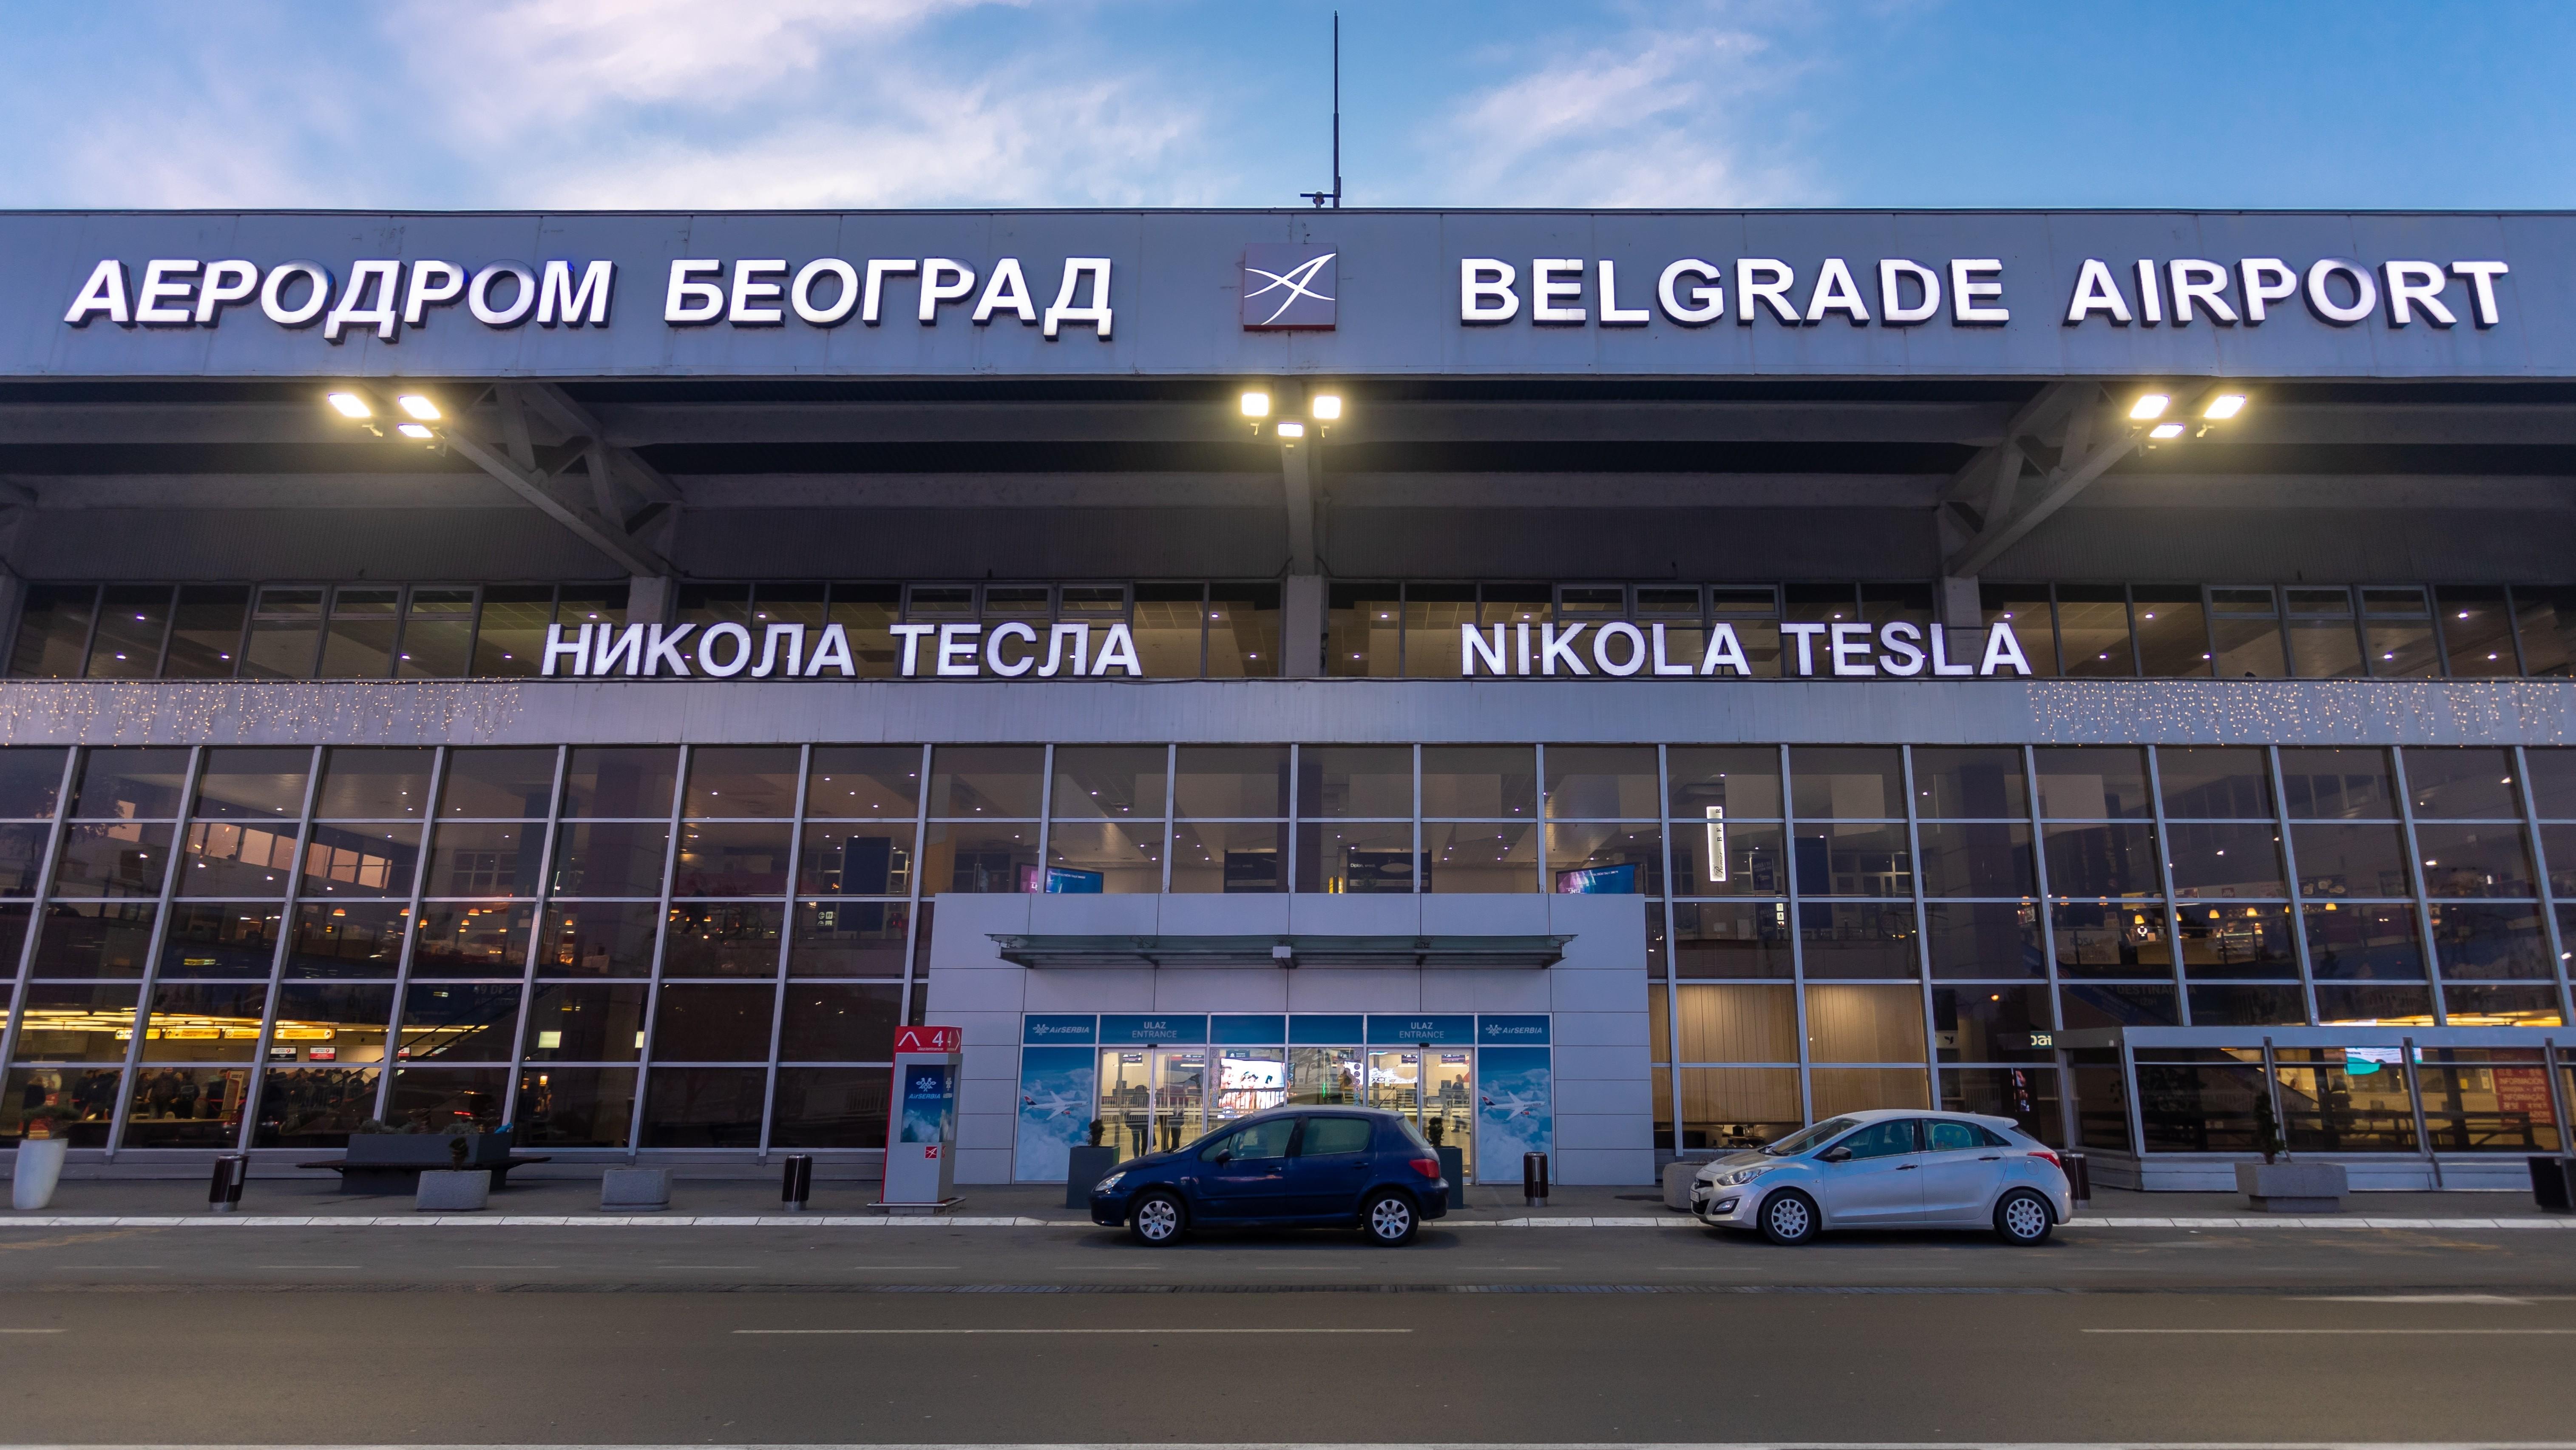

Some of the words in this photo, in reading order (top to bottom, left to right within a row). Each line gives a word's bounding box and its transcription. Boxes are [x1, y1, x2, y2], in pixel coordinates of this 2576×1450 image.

[64, 259, 614, 342] АЕРОДРОМ
[664, 257, 1114, 338] БЕОГРАД
[1460, 257, 2009, 324] BELGRADE
[2065, 257, 2510, 327] AIRPORT
[543, 623, 855, 677] НИКОЛА
[890, 623, 1143, 677] ТЕСЛА
[1461, 623, 1752, 677] NIKOLA
[1781, 623, 2032, 677] TESLA
[1712, 848, 1724, 879] Premier
[932, 1031, 943, 1046] 4
